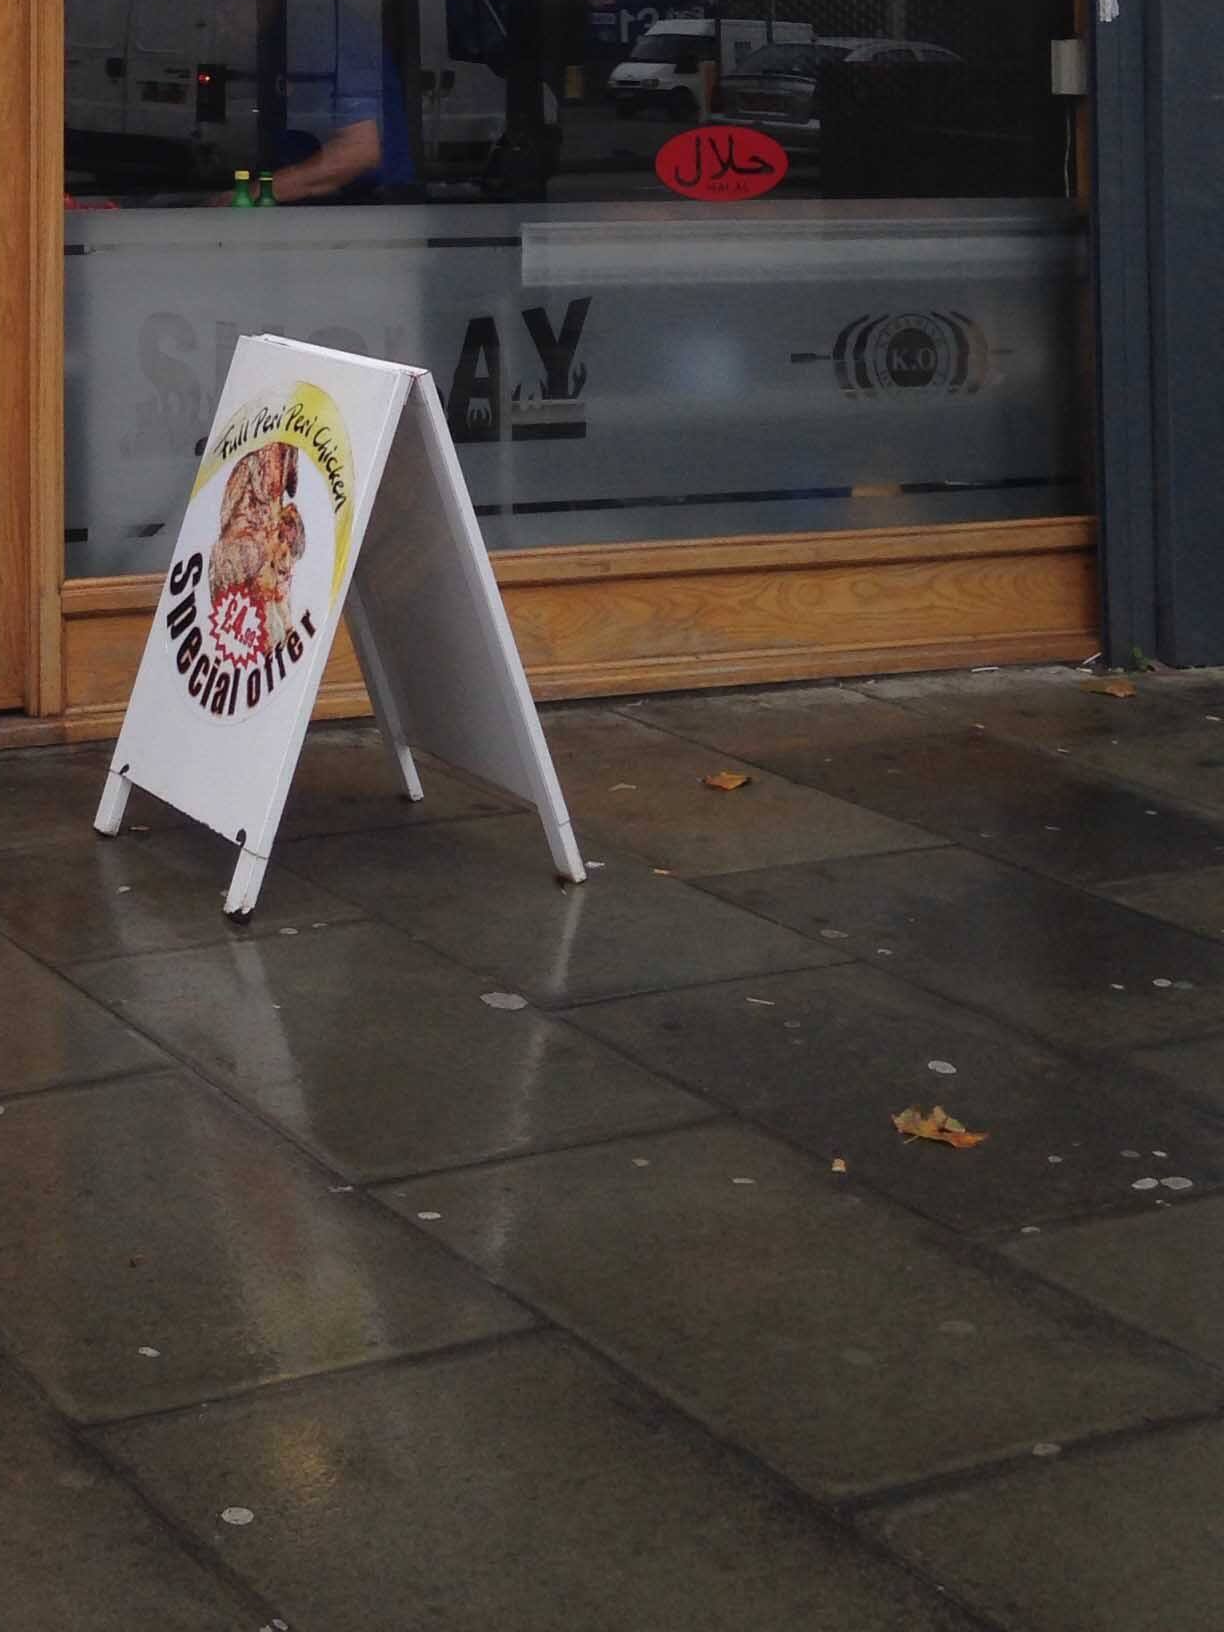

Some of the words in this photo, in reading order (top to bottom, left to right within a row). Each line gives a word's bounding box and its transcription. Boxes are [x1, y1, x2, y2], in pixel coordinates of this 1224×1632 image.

[674, 134, 775, 188] حلال
[215, 420, 250, 460] Full
[252, 406, 286, 438] Peri
[285, 403, 318, 437] Peri
[312, 426, 347, 514] Chicken
[167, 552, 241, 716] Special
[247, 609, 316, 708] offer
